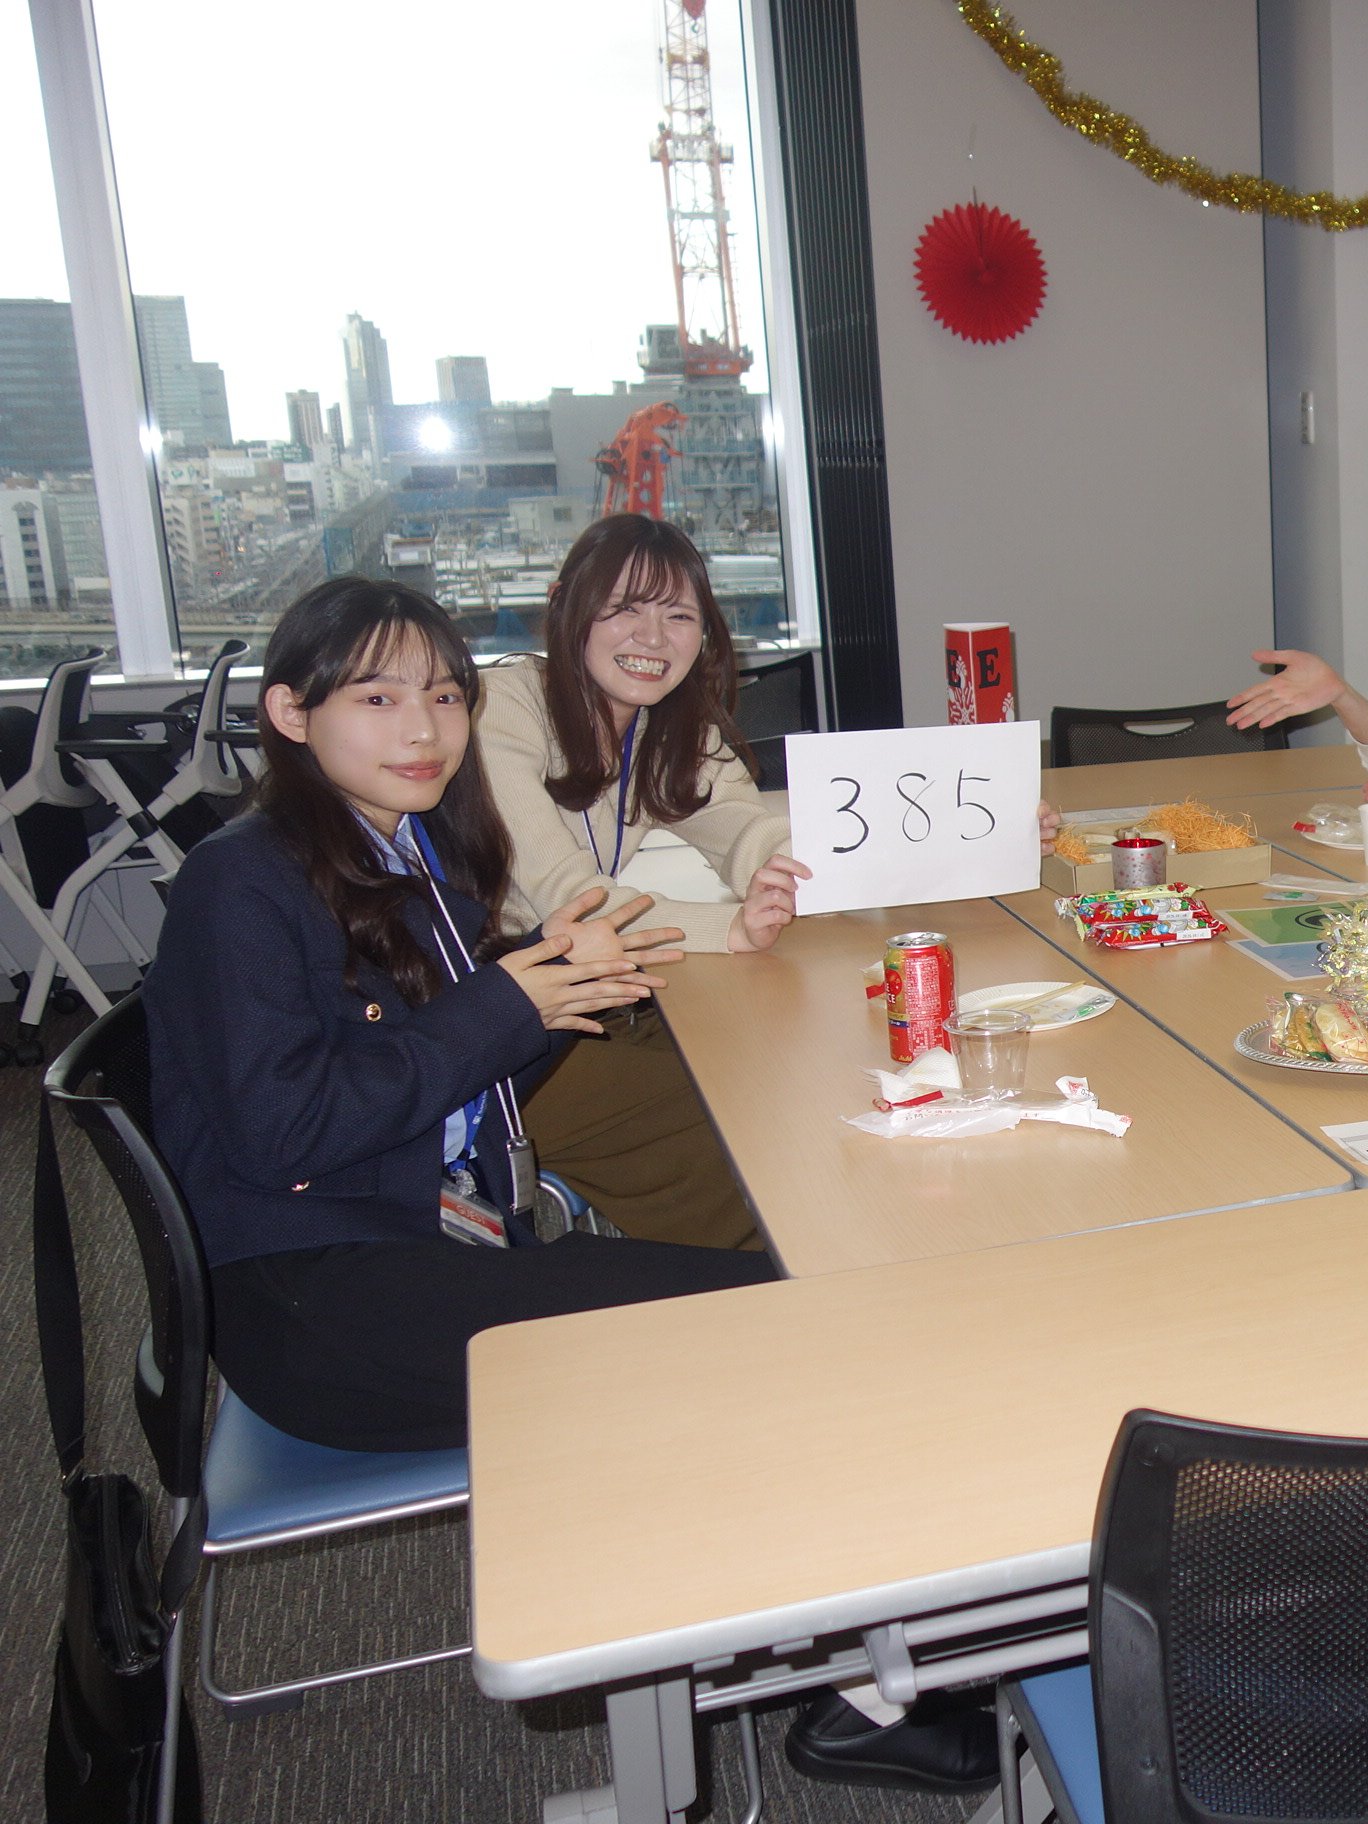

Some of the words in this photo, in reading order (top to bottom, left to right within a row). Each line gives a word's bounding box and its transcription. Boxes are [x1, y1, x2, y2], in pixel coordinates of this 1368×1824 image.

[976, 647, 1001, 689] E
[829, 768, 996, 854] 385
[456, 1205, 486, 1225] GUEST
